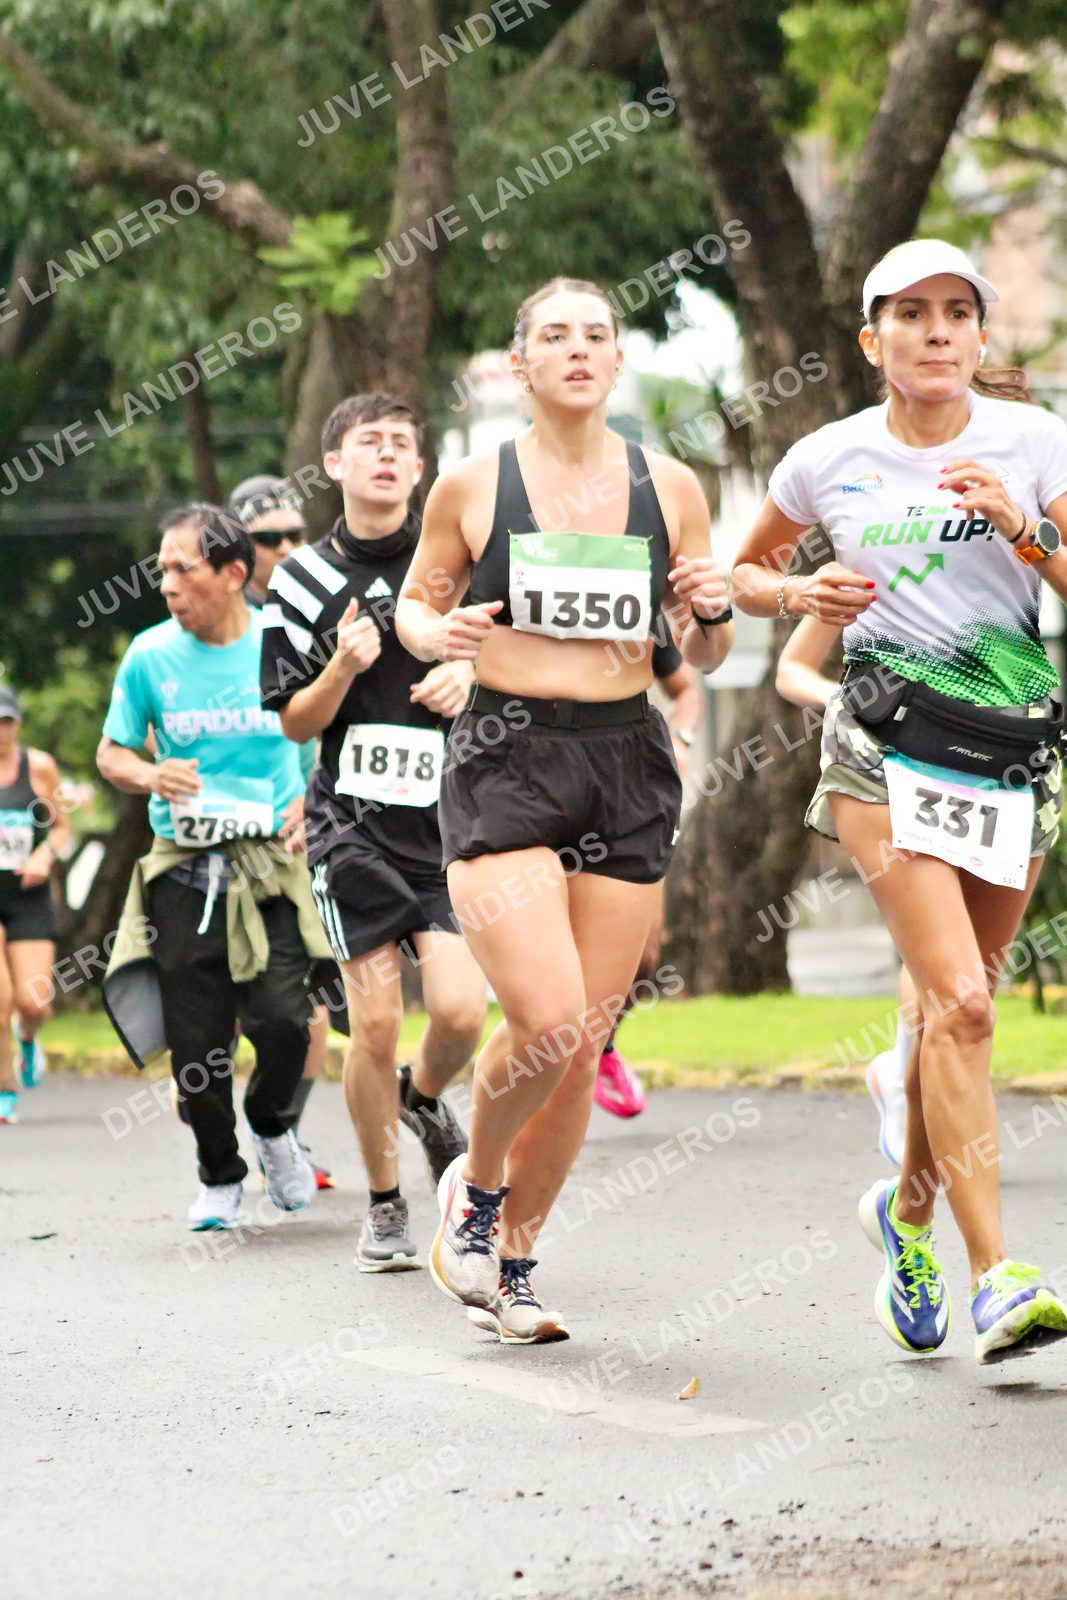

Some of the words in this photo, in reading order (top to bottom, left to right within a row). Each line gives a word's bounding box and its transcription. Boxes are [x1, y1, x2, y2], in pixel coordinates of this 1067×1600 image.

[907, 504, 949, 518] TEAM
[859, 520, 934, 549] RUN
[524, 590, 641, 631] 1350
[352, 744, 435, 782] 1818
[914, 786, 999, 849] 331
